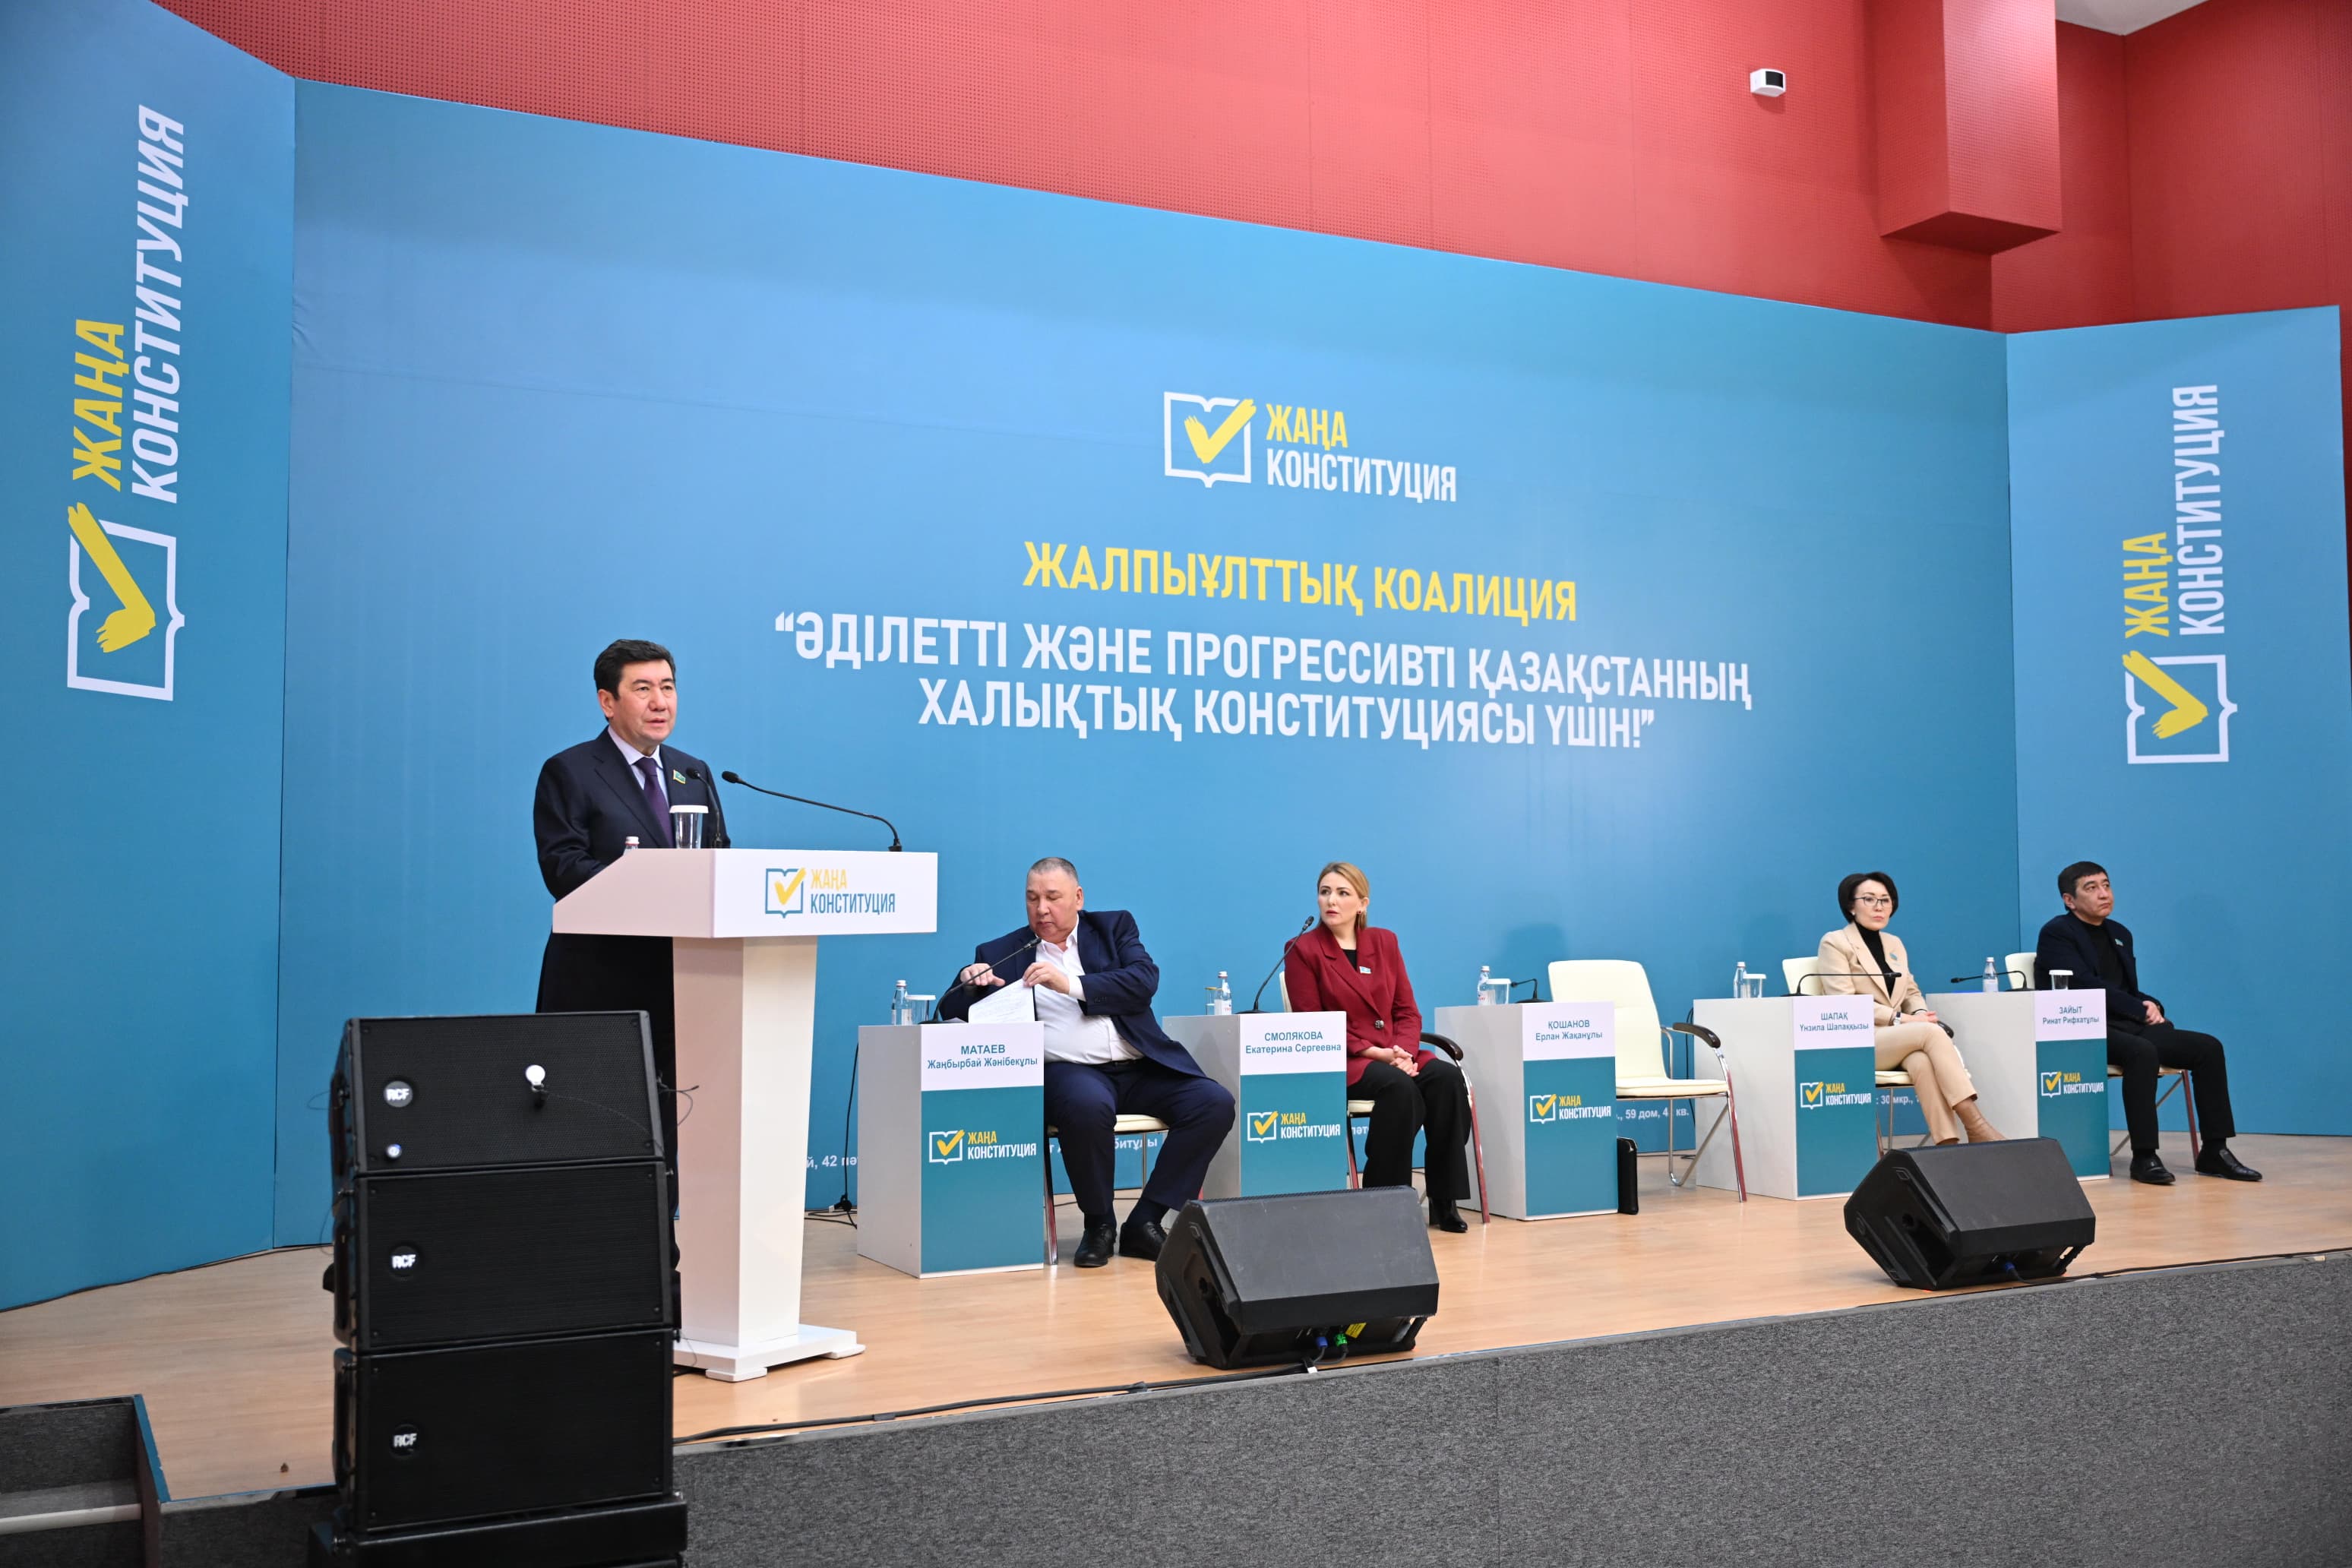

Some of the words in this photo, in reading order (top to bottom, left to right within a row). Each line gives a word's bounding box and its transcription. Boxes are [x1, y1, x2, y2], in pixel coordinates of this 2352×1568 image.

[131, 104, 189, 504] КОНСТИТУЦИЯ
[72, 318, 129, 492] ЖАҢА
[1266, 403, 1348, 450] ЖАҢА
[1266, 448, 1457, 503] КОНСТИТУЦИЯ
[2172, 384, 2225, 636] КОНСТИТУЦИЯ
[1023, 541, 1363, 616] ЖАЛПЫҰЛТТЫҚ
[1374, 567, 1577, 627] КОАЛИЦИЯ
[2123, 532, 2173, 638] ЖАҢА
[1022, 623, 1152, 674] ЖӘНЕ
[1167, 631, 1455, 688] ПРОГРЕССИВТІ
[1468, 647, 1753, 710] ҚАЗАҚСТАННЫҢ
[918, 678, 1182, 741] ХАЛЫҚТЫҚ
[1195, 688, 1535, 750] КОНСТИТУЦИЯСЫ
[810, 868, 848, 891] ЖАҢА
[810, 893, 896, 915] КОНСТИТУЦИЯ
[1821, 1012, 1848, 1021] ШАПАҚ
[2059, 1005, 2082, 1014] ЗАЙЫТ
[1548, 1020, 1590, 1030] ҚОШАНОВ
[1800, 1023, 1825, 1032] Үнзила
[1826, 1023, 1869, 1032] Шапаққызы
[1264, 1031, 1323, 1042] СМОЛЯКОВА
[1535, 1032, 1560, 1042] Ерлан
[1562, 1031, 1603, 1040] Жақанұлы
[960, 1044, 1006, 1055] МАТАЕВ
[1245, 1045, 1293, 1054] Екатерина
[1295, 1044, 1342, 1054] Сергеевна
[927, 1058, 982, 1070] Жаңбырбай
[984, 1057, 1038, 1067] Жәнібекұлы
[2063, 1072, 2081, 1083] ЖАҢА
[387, 1088, 409, 1101] RCF
[1826, 1083, 1845, 1094] ЖАҢА
[2063, 1082, 2104, 1095] КОНСТИТУЦИЯ
[1559, 1095, 1581, 1108] ЖАҢА
[1826, 1092, 1871, 1106] КОНСТИТУЦИЯ
[1280, 1112, 1307, 1127] ЖАҢА
[1559, 1105, 1611, 1120] КОНСТИТУЦИЯ
[1626, 1108, 1637, 1119] 59
[1638, 1109, 1661, 1121] дом,
[1676, 1108, 1690, 1117] кв.
[968, 1130, 997, 1146] ЖАҢА
[1280, 1124, 1341, 1140] КОНСТИТУЦИЯ
[967, 1143, 1037, 1161] КОНСТИТУЦИЯ
[821, 1155, 837, 1167] 42
[392, 1253, 416, 1269] RCF
[394, 1433, 417, 1447] RCF
